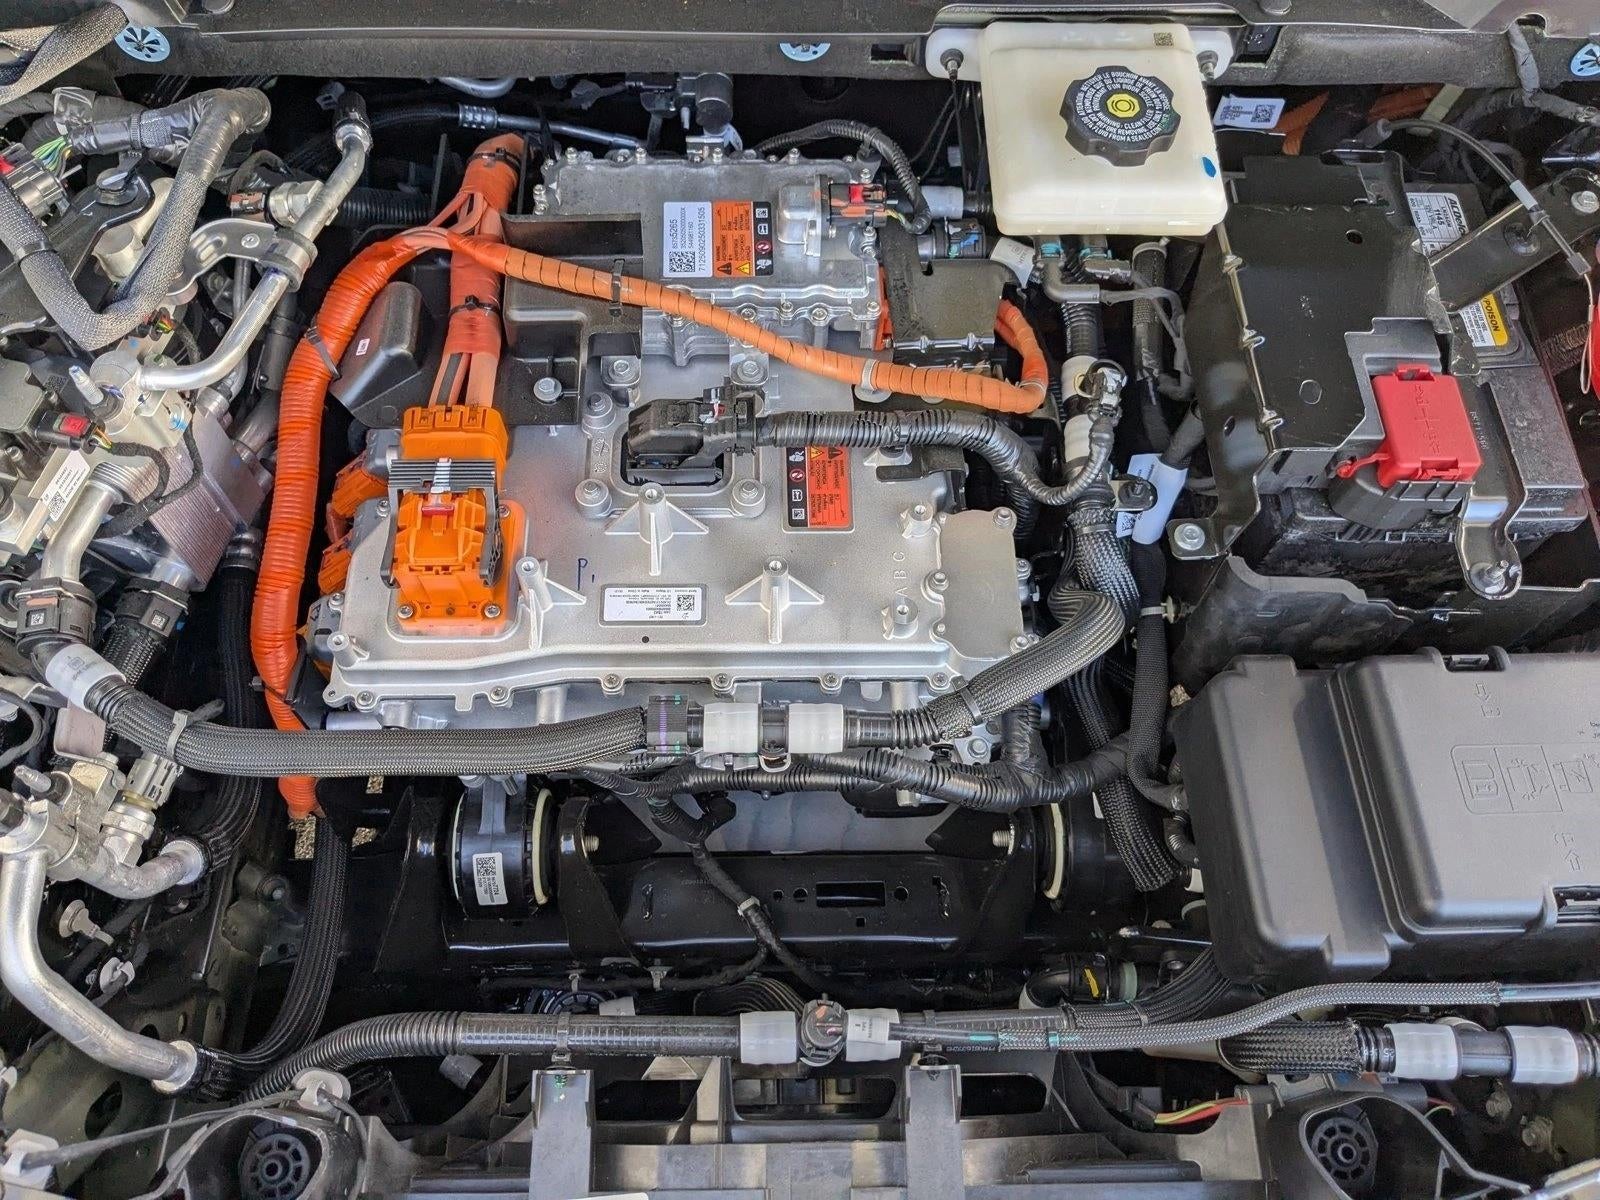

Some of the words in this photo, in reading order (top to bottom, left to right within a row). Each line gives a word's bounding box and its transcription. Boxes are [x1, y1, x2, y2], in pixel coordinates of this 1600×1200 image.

[1110, 72, 1138, 81] BOUCHON
[1138, 76, 1156, 88] AVANT
[1154, 86, 1162, 94] LA
[1142, 86, 1158, 98] FREIN
[1088, 113, 1100, 122] CAP
[1096, 120, 1118, 134] BEFORE
[1146, 120, 1158, 129] USE
[1124, 121, 1143, 130] CLEAN
[1092, 126, 1109, 137] FLUID
[1108, 132, 1126, 142] FROM
[1130, 132, 1153, 142] SEALED
[1433, 208, 1445, 226] 1145
